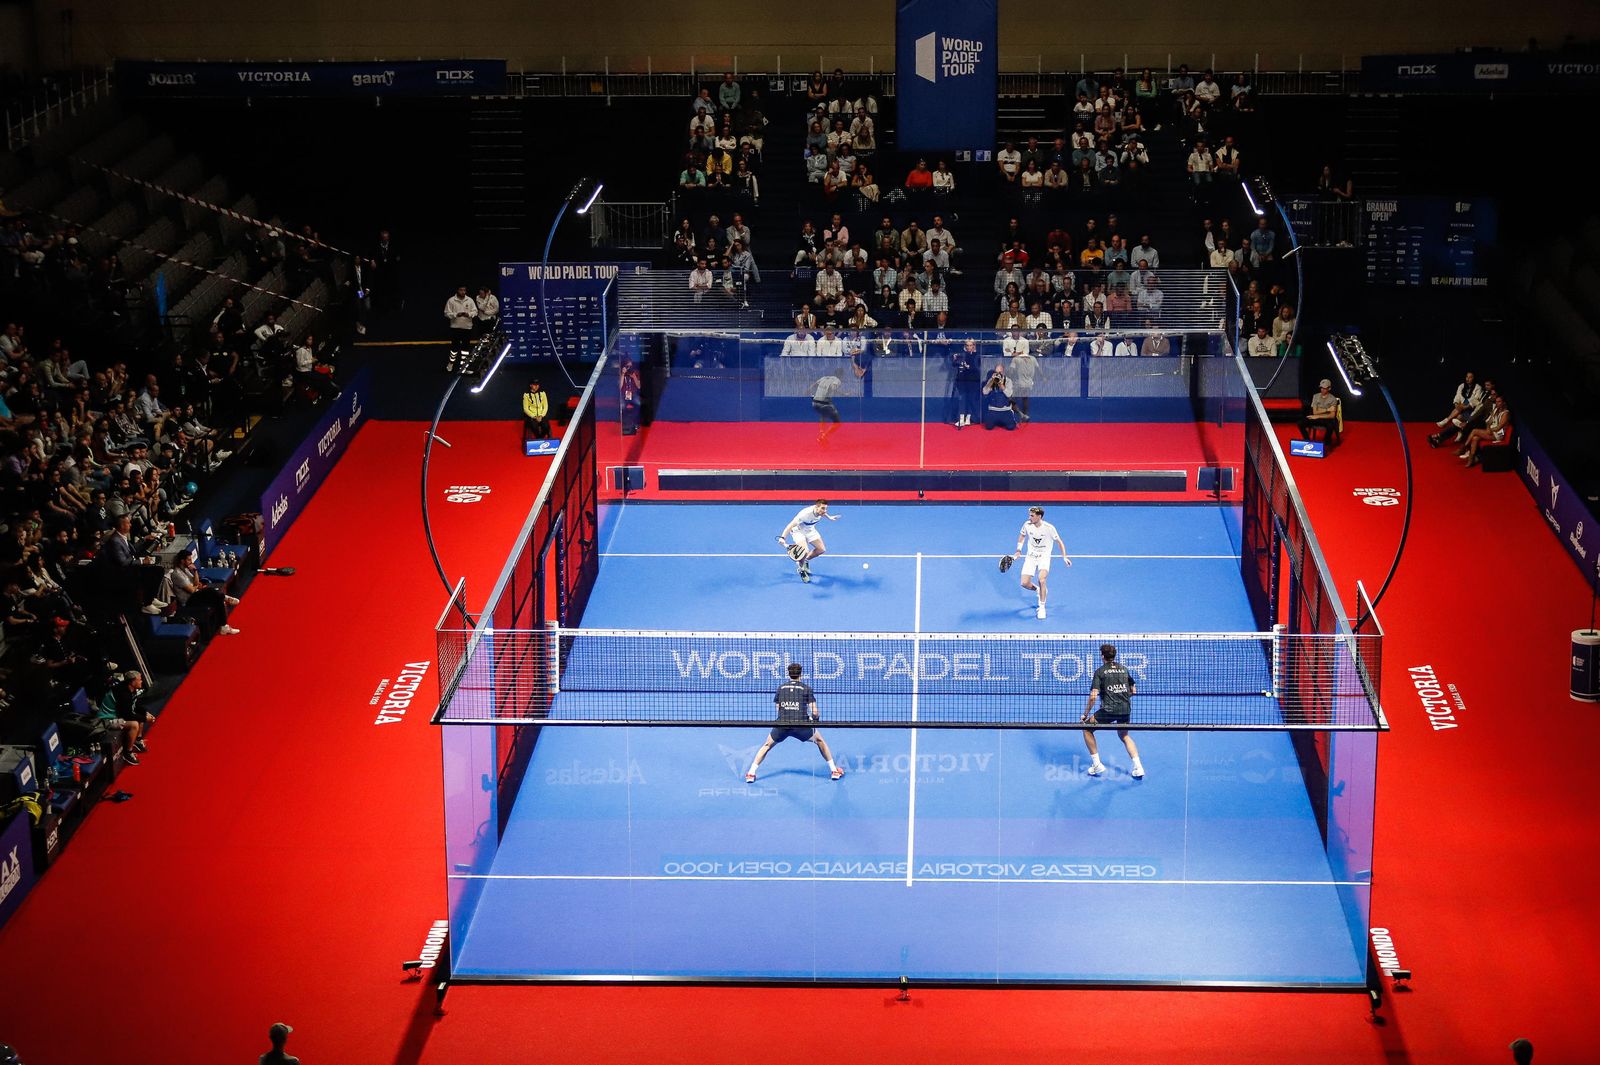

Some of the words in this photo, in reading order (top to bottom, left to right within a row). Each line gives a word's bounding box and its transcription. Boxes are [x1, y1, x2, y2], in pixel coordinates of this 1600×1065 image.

[942, 37, 983, 52] WORLD
[942, 51, 980, 64] PADEL
[238, 72, 311, 82] VICTORIA
[942, 63, 975, 77] TOUR
[1366, 202, 1397, 212] GRANADA
[528, 266, 561, 280] WORLD
[562, 266, 592, 280] PADEL
[672, 650, 846, 680] WORLD
[857, 652, 1009, 681] PADEL
[374, 660, 430, 725] VICTORIA
[1408, 665, 1458, 730] VICTORIA
[419, 927, 449, 968] MONDO
[1370, 927, 1400, 968] MONDO
